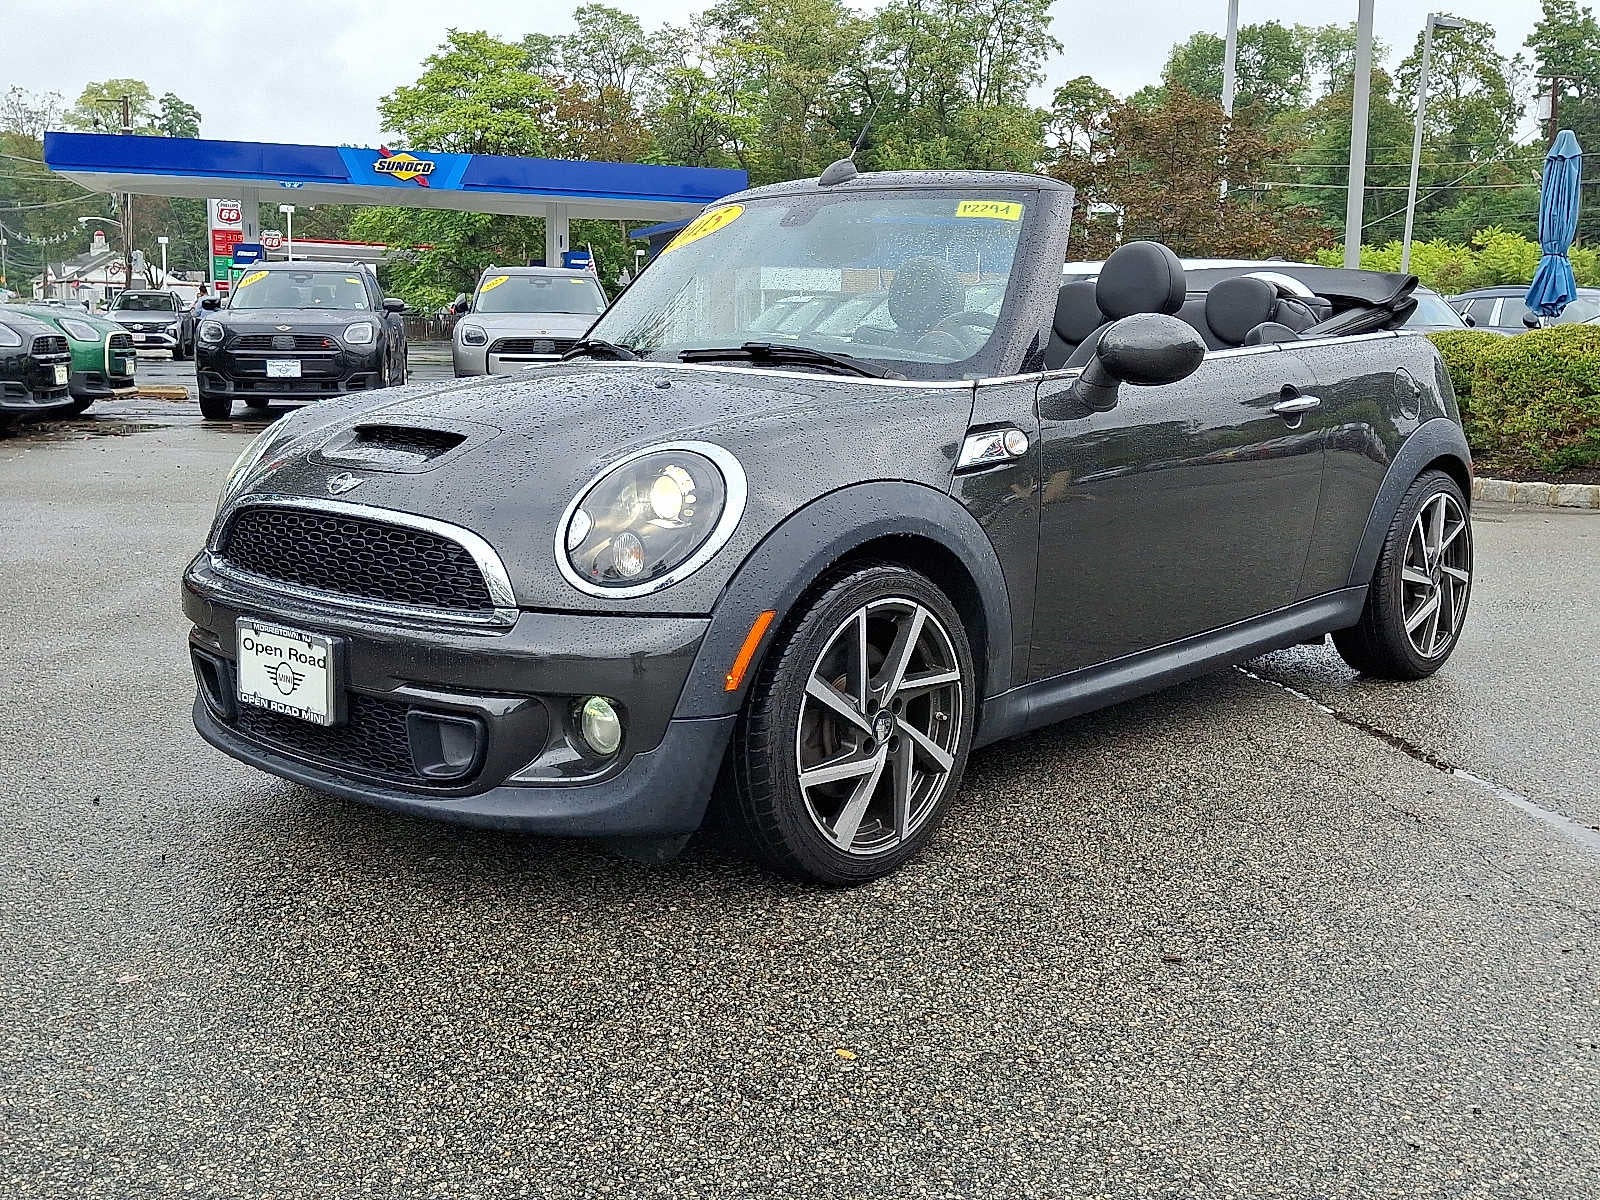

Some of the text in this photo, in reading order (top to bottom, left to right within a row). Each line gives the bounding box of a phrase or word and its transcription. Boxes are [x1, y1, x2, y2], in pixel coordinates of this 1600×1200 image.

[377, 160, 432, 173] SUNOCO
[221, 209, 238, 220] 66
[243, 637, 327, 670] Open Road
[278, 673, 293, 685] MINI
[241, 693, 324, 725] OPEN ROAD MINI
